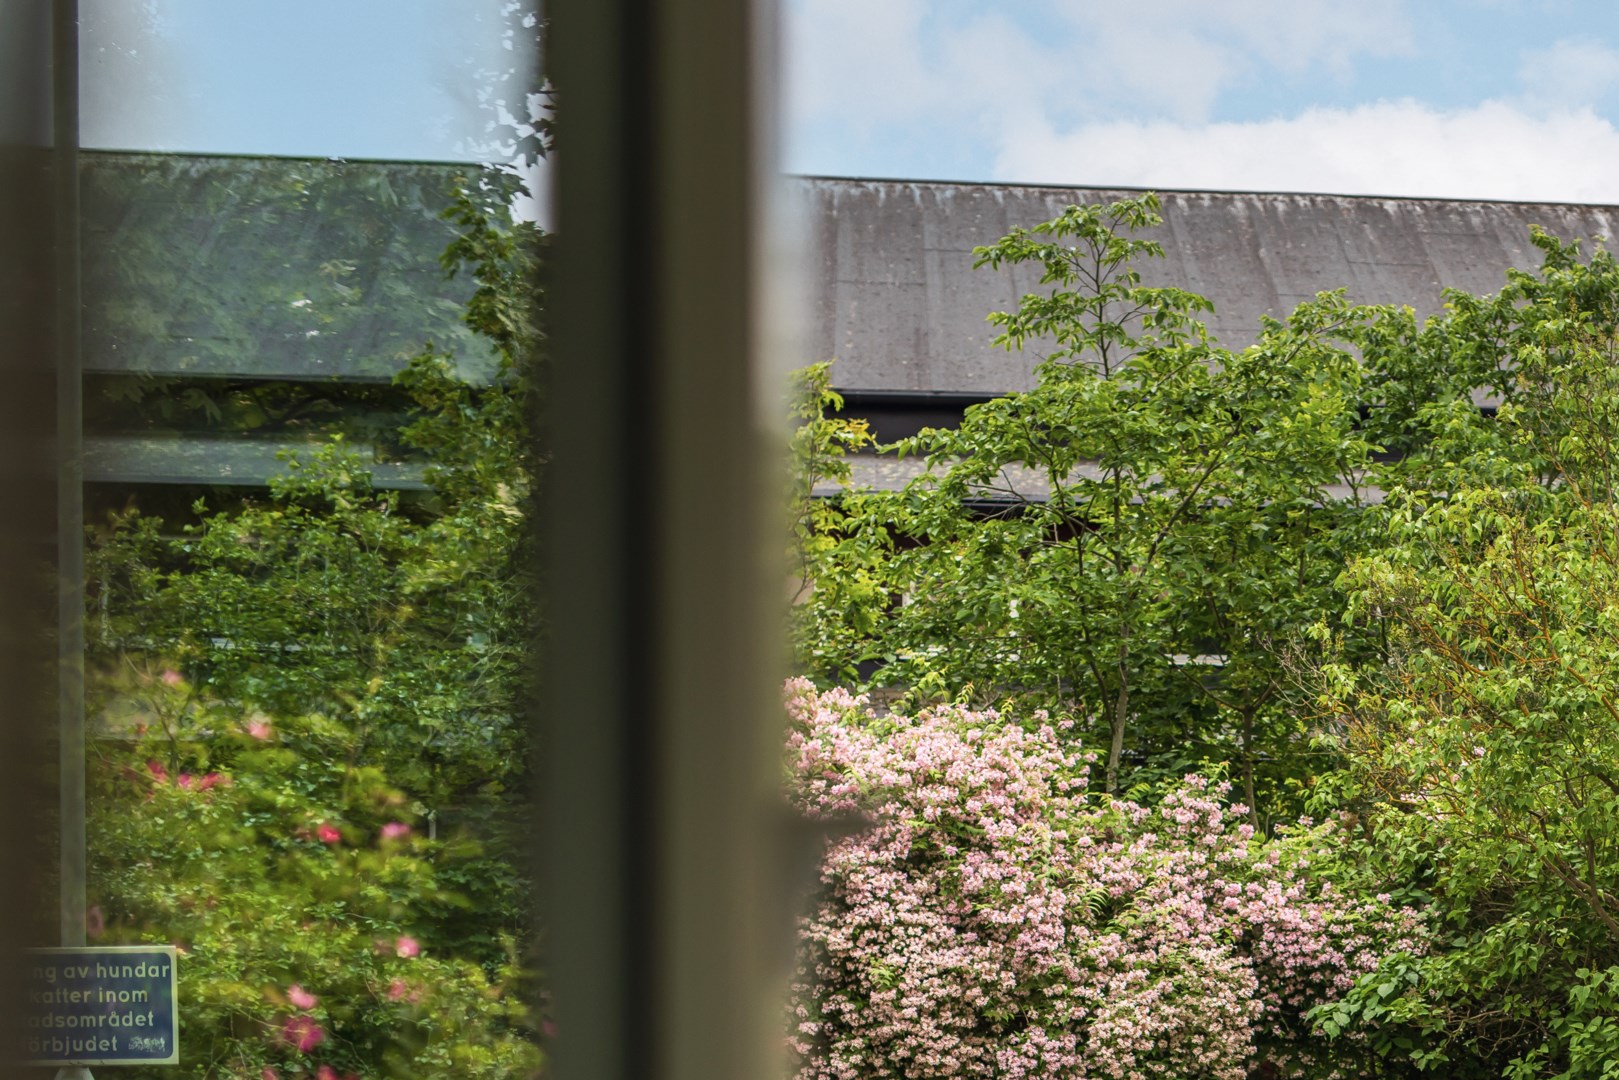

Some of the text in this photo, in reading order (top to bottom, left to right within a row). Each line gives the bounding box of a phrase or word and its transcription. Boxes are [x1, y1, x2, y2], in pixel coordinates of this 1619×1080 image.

[32, 962, 170, 983] ng av hundar
[30, 987, 149, 1004] katter inom
[27, 1010, 155, 1028] adsområdet
[28, 1035, 118, 1056] örbjudet
